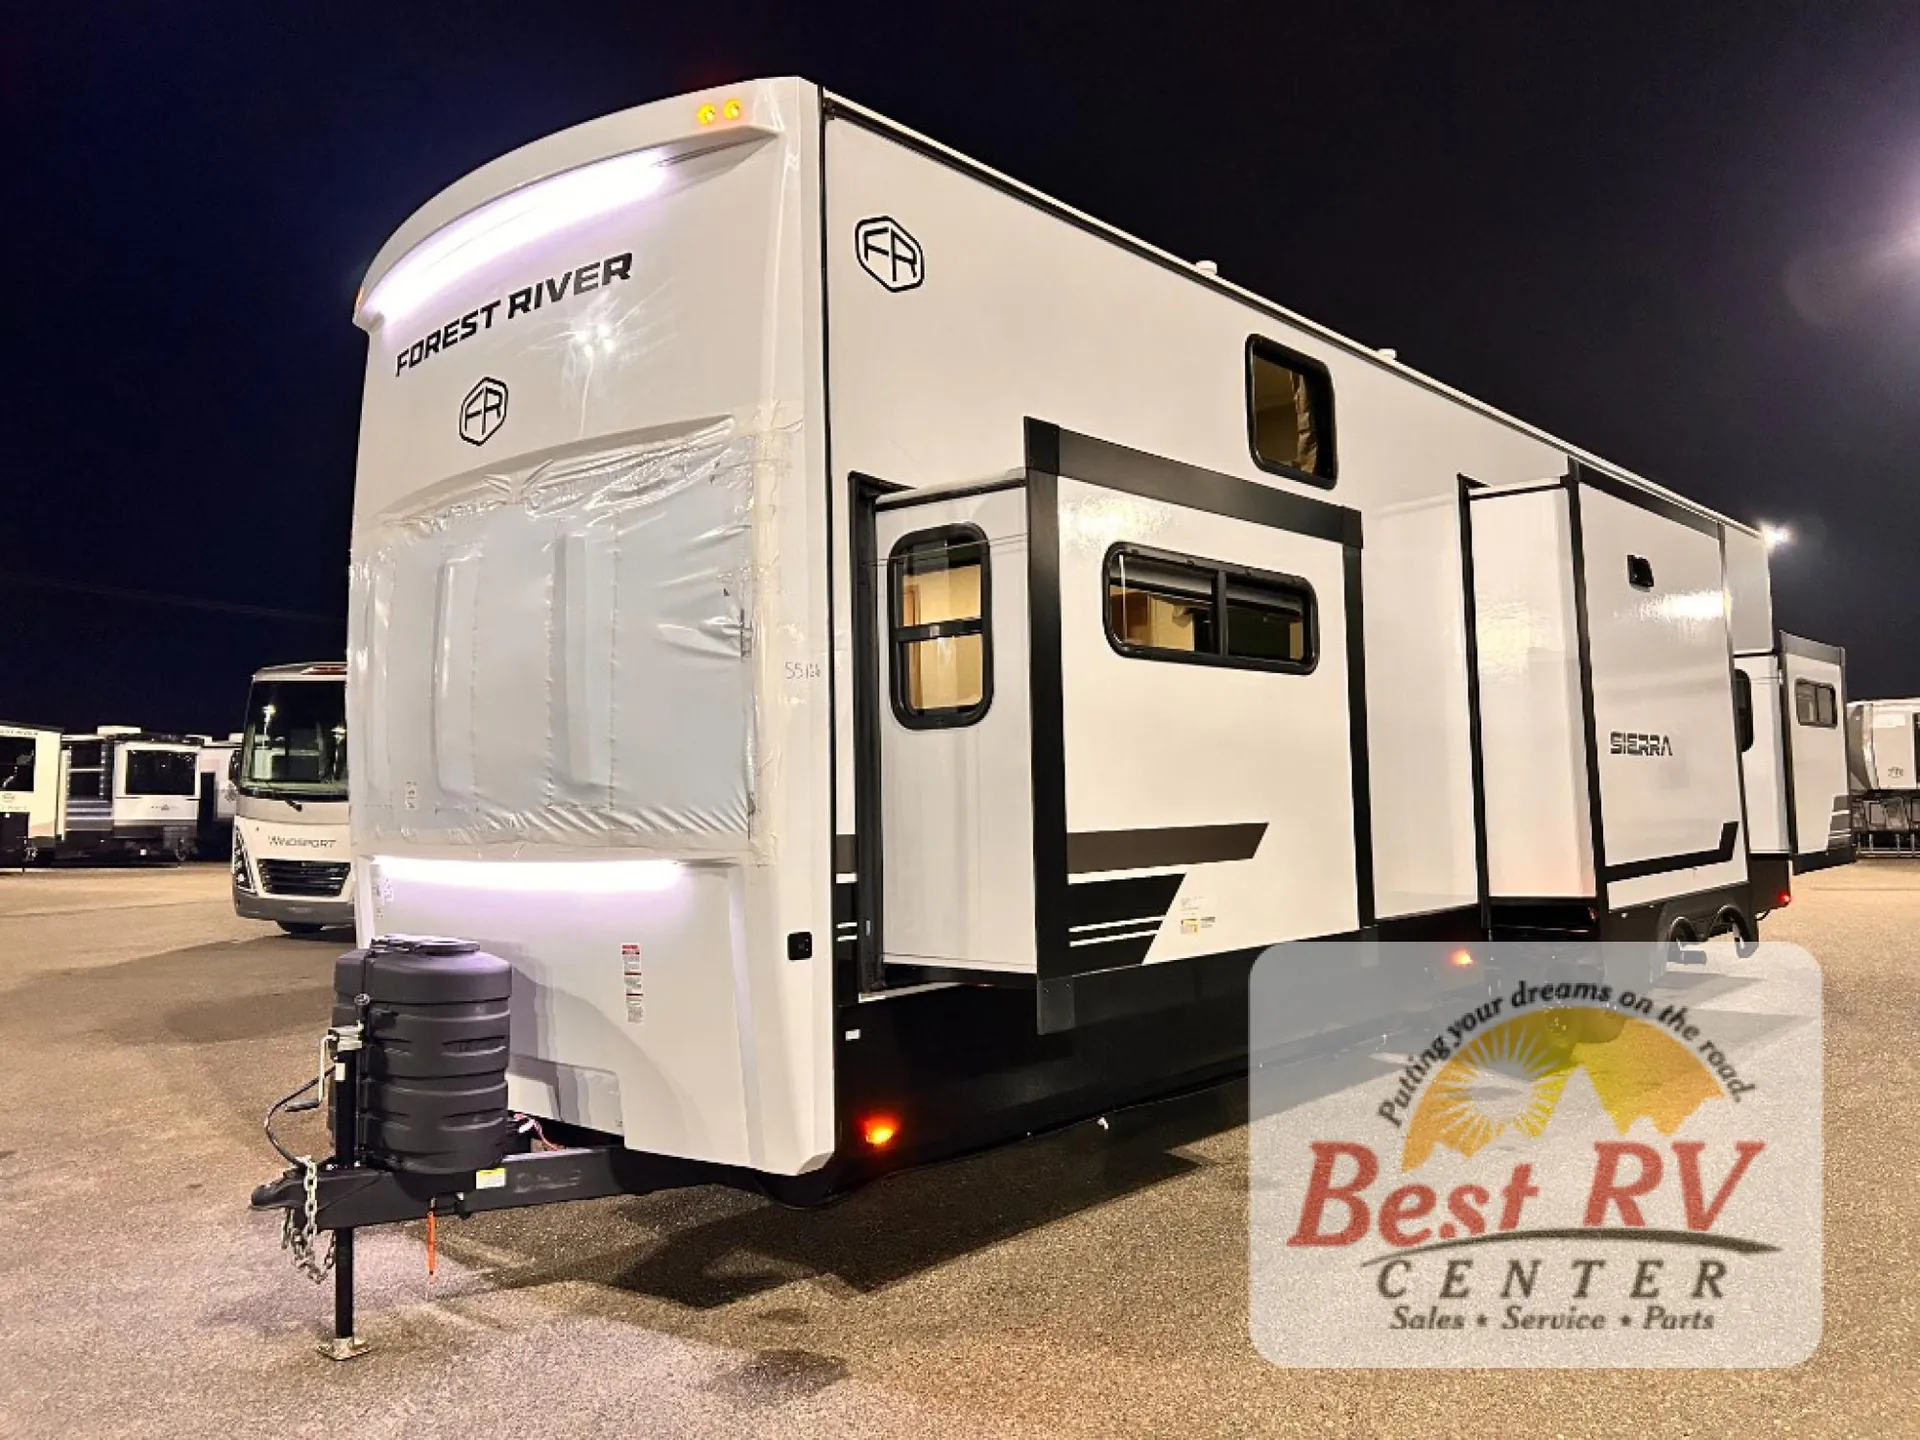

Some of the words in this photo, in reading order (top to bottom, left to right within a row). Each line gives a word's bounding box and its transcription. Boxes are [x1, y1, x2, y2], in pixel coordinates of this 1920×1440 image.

[395, 299, 502, 378] FOREST
[506, 251, 634, 320] RIVER
[1610, 731, 1673, 756] SIERRA
